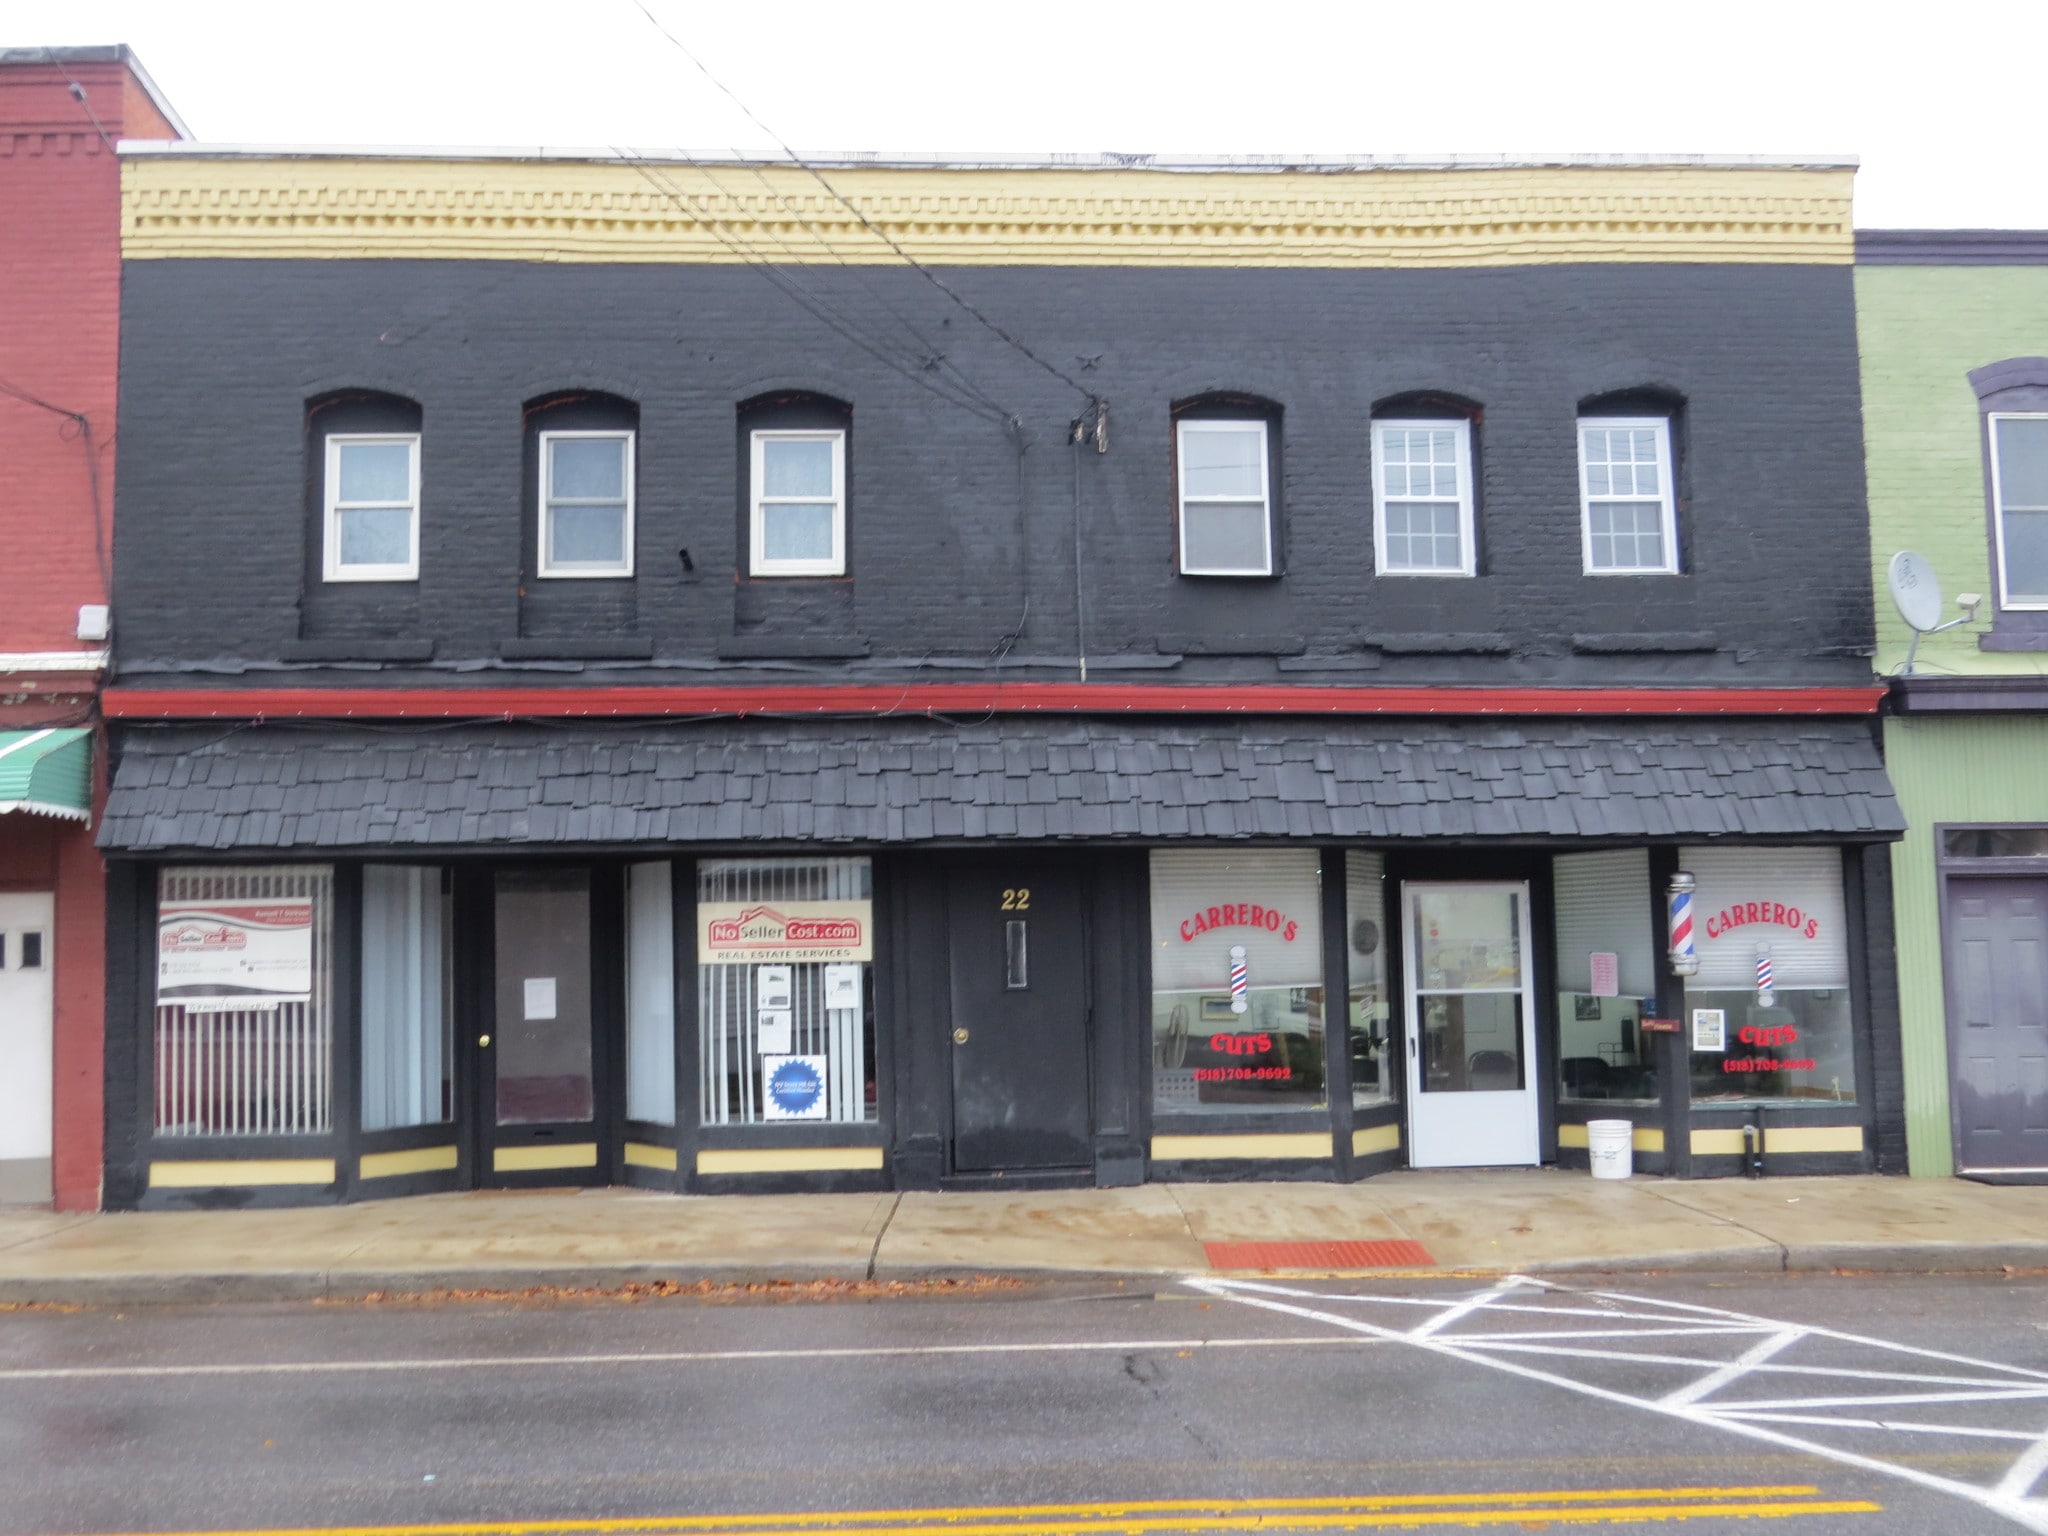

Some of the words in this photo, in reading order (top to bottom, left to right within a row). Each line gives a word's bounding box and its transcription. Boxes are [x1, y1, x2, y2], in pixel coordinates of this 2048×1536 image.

[1001, 888, 1030, 910] 22
[1180, 903, 1298, 942] CARRERO'S
[1706, 901, 1818, 938] CARRERO'S
[717, 951, 745, 960] REAL
[750, 950, 792, 959] ESTATE
[795, 948, 851, 958] SERVICES
